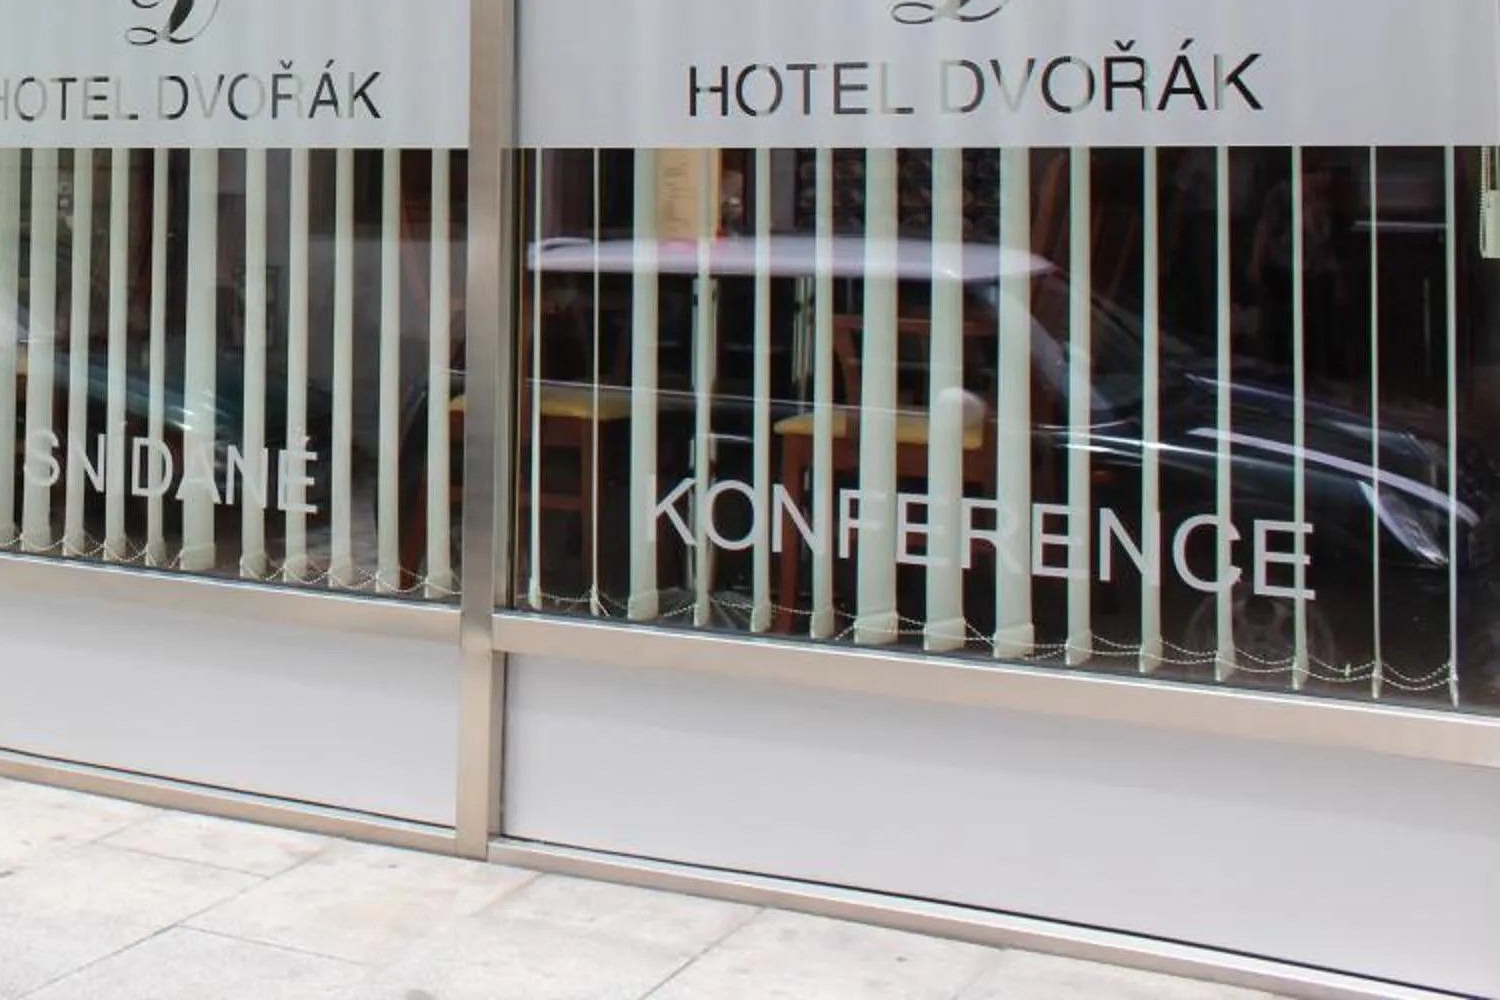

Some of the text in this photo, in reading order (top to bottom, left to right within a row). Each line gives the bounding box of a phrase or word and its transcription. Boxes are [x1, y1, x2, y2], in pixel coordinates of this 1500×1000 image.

[157, 59, 382, 121] DVOŘÁK
[688, 37, 1263, 117] HOTEL DVOŘÁK
[646, 474, 1316, 600] KONFERENCE
